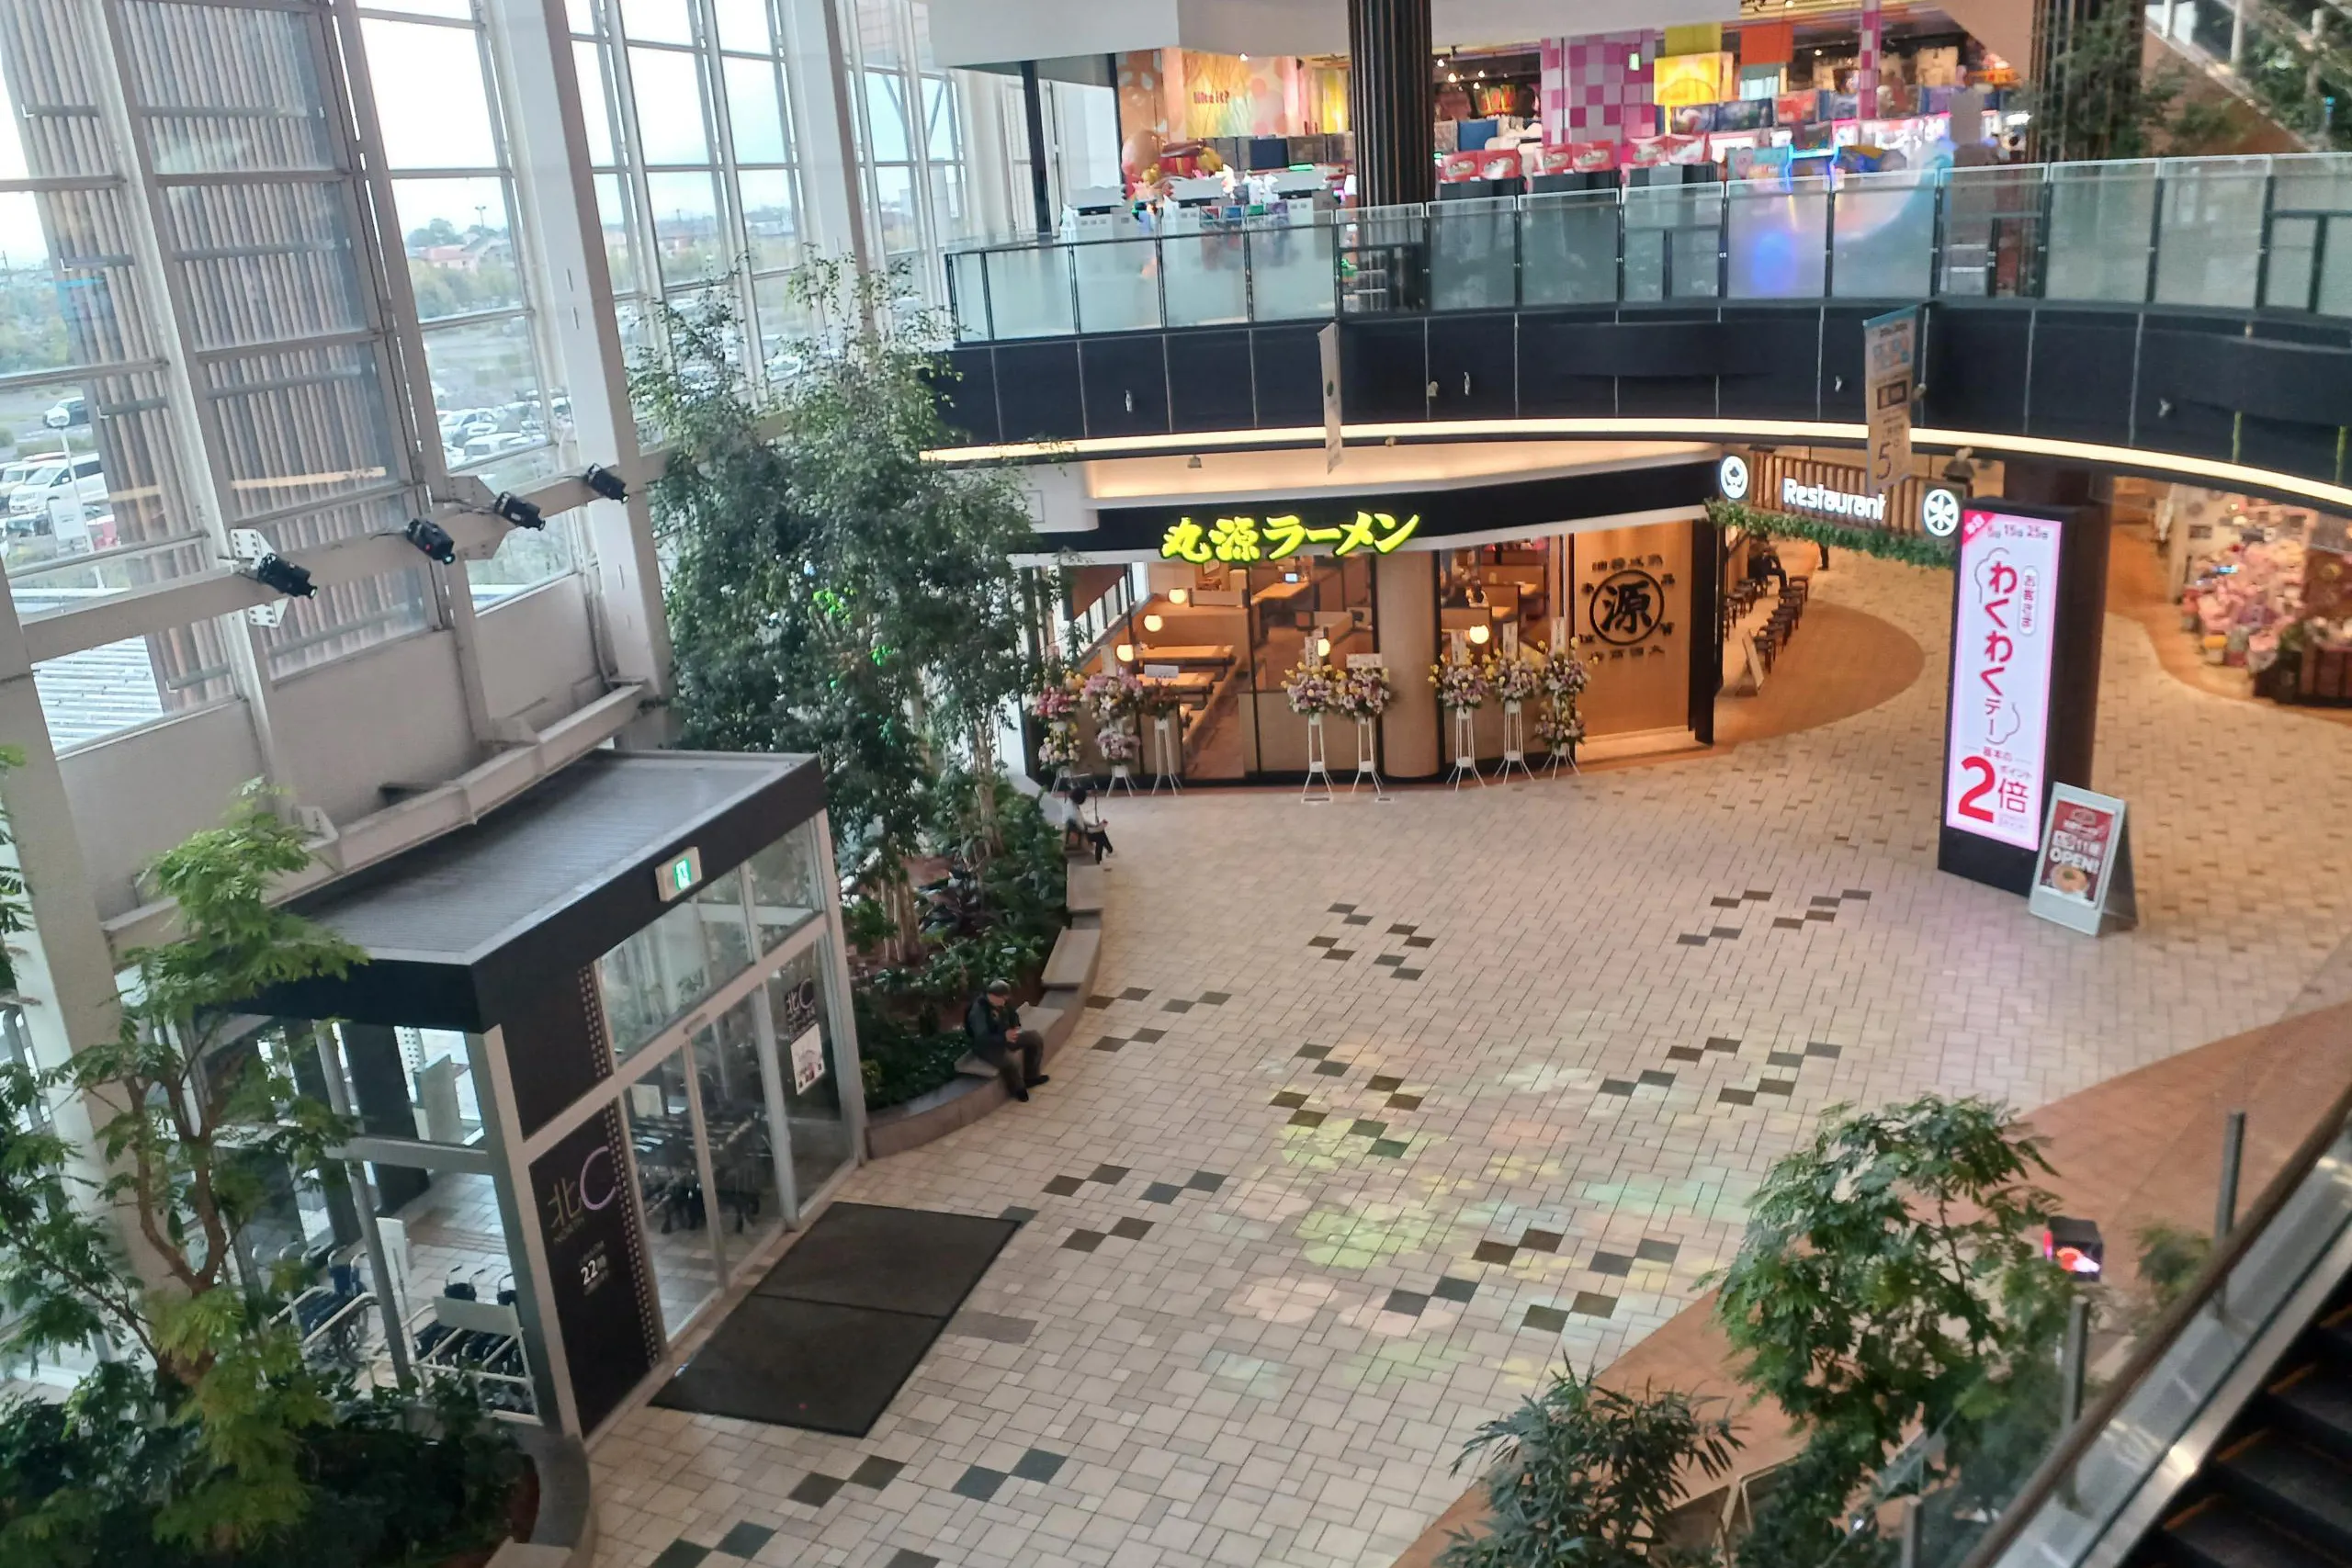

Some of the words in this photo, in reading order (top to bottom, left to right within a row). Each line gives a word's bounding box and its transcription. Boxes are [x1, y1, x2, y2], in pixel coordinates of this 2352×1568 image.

[1782, 477, 1886, 521] Restaurant
[1162, 511, 1419, 563] 丸源ラーメン
[1979, 560, 2018, 736] わくわくデー
[1958, 755, 2030, 824] 2倍
